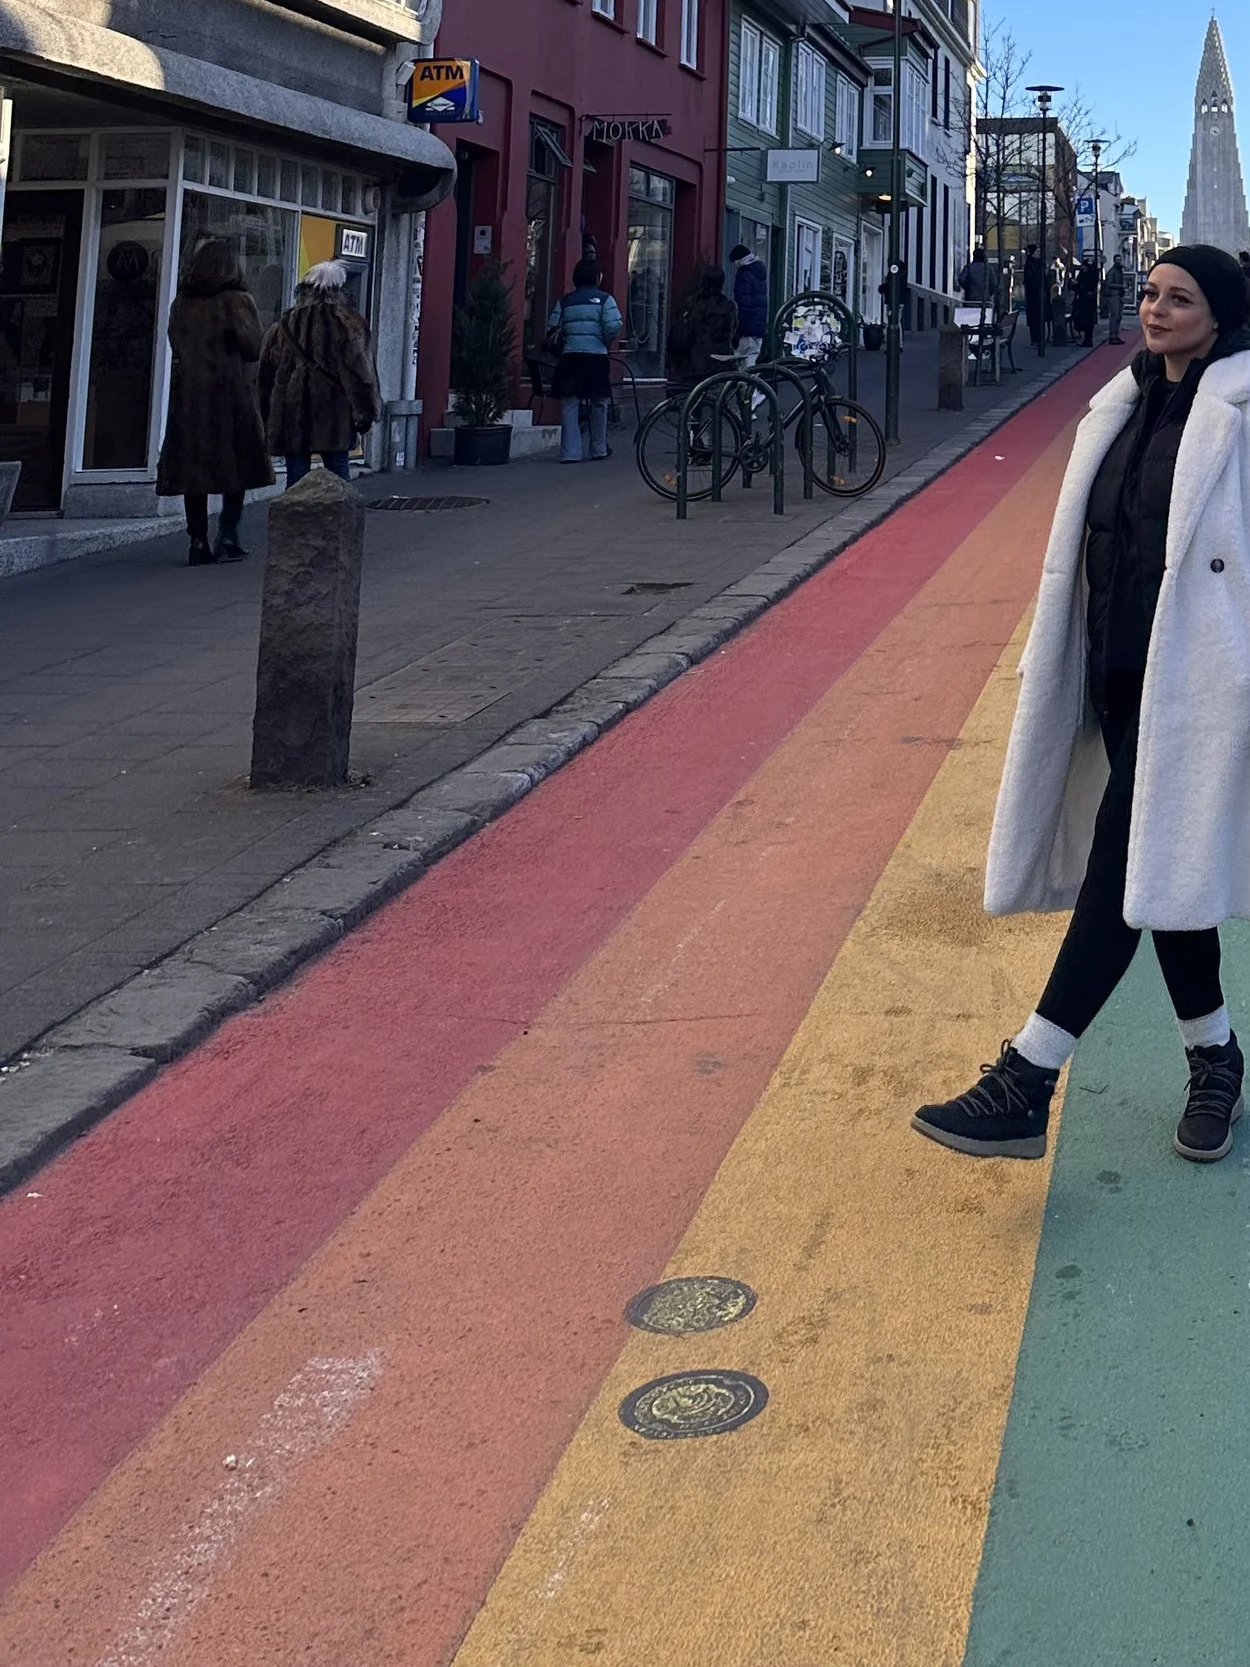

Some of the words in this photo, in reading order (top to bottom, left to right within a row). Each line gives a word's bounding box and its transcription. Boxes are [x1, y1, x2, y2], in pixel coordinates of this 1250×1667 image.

[419, 65, 465, 81] ATM
[592, 119, 665, 143] MOKKA
[772, 159, 813, 169] Kaolin
[1080, 200, 1089, 213] P
[342, 233, 364, 254] ATM
